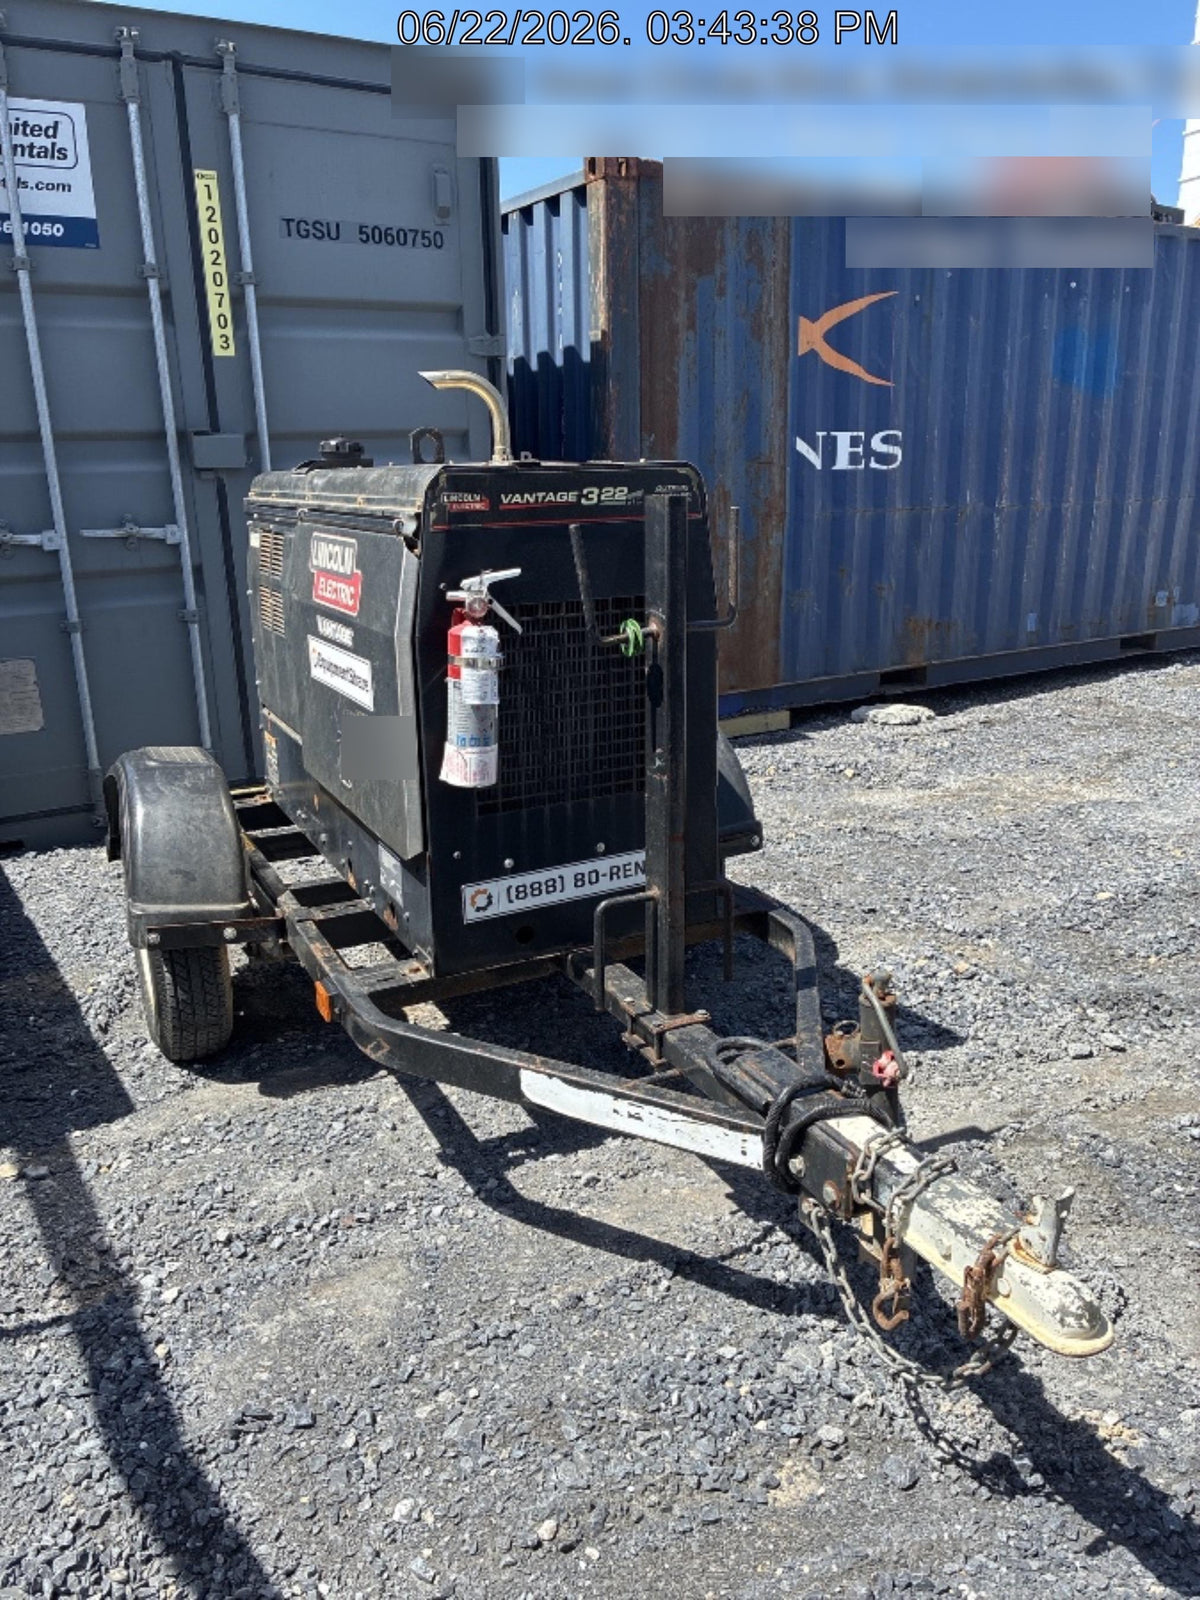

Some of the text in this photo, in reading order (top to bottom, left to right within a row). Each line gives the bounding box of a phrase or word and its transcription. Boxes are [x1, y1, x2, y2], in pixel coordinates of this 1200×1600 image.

[281, 218, 444, 249] TGSU 5060750
[203, 184, 231, 351] 12020703
[500, 491, 578, 504] VANTAGE
[580, 486, 628, 506] 322
[312, 540, 356, 575] LINCOLN
[318, 576, 355, 606] ELECTRIC
[505, 875, 565, 903] (888)
